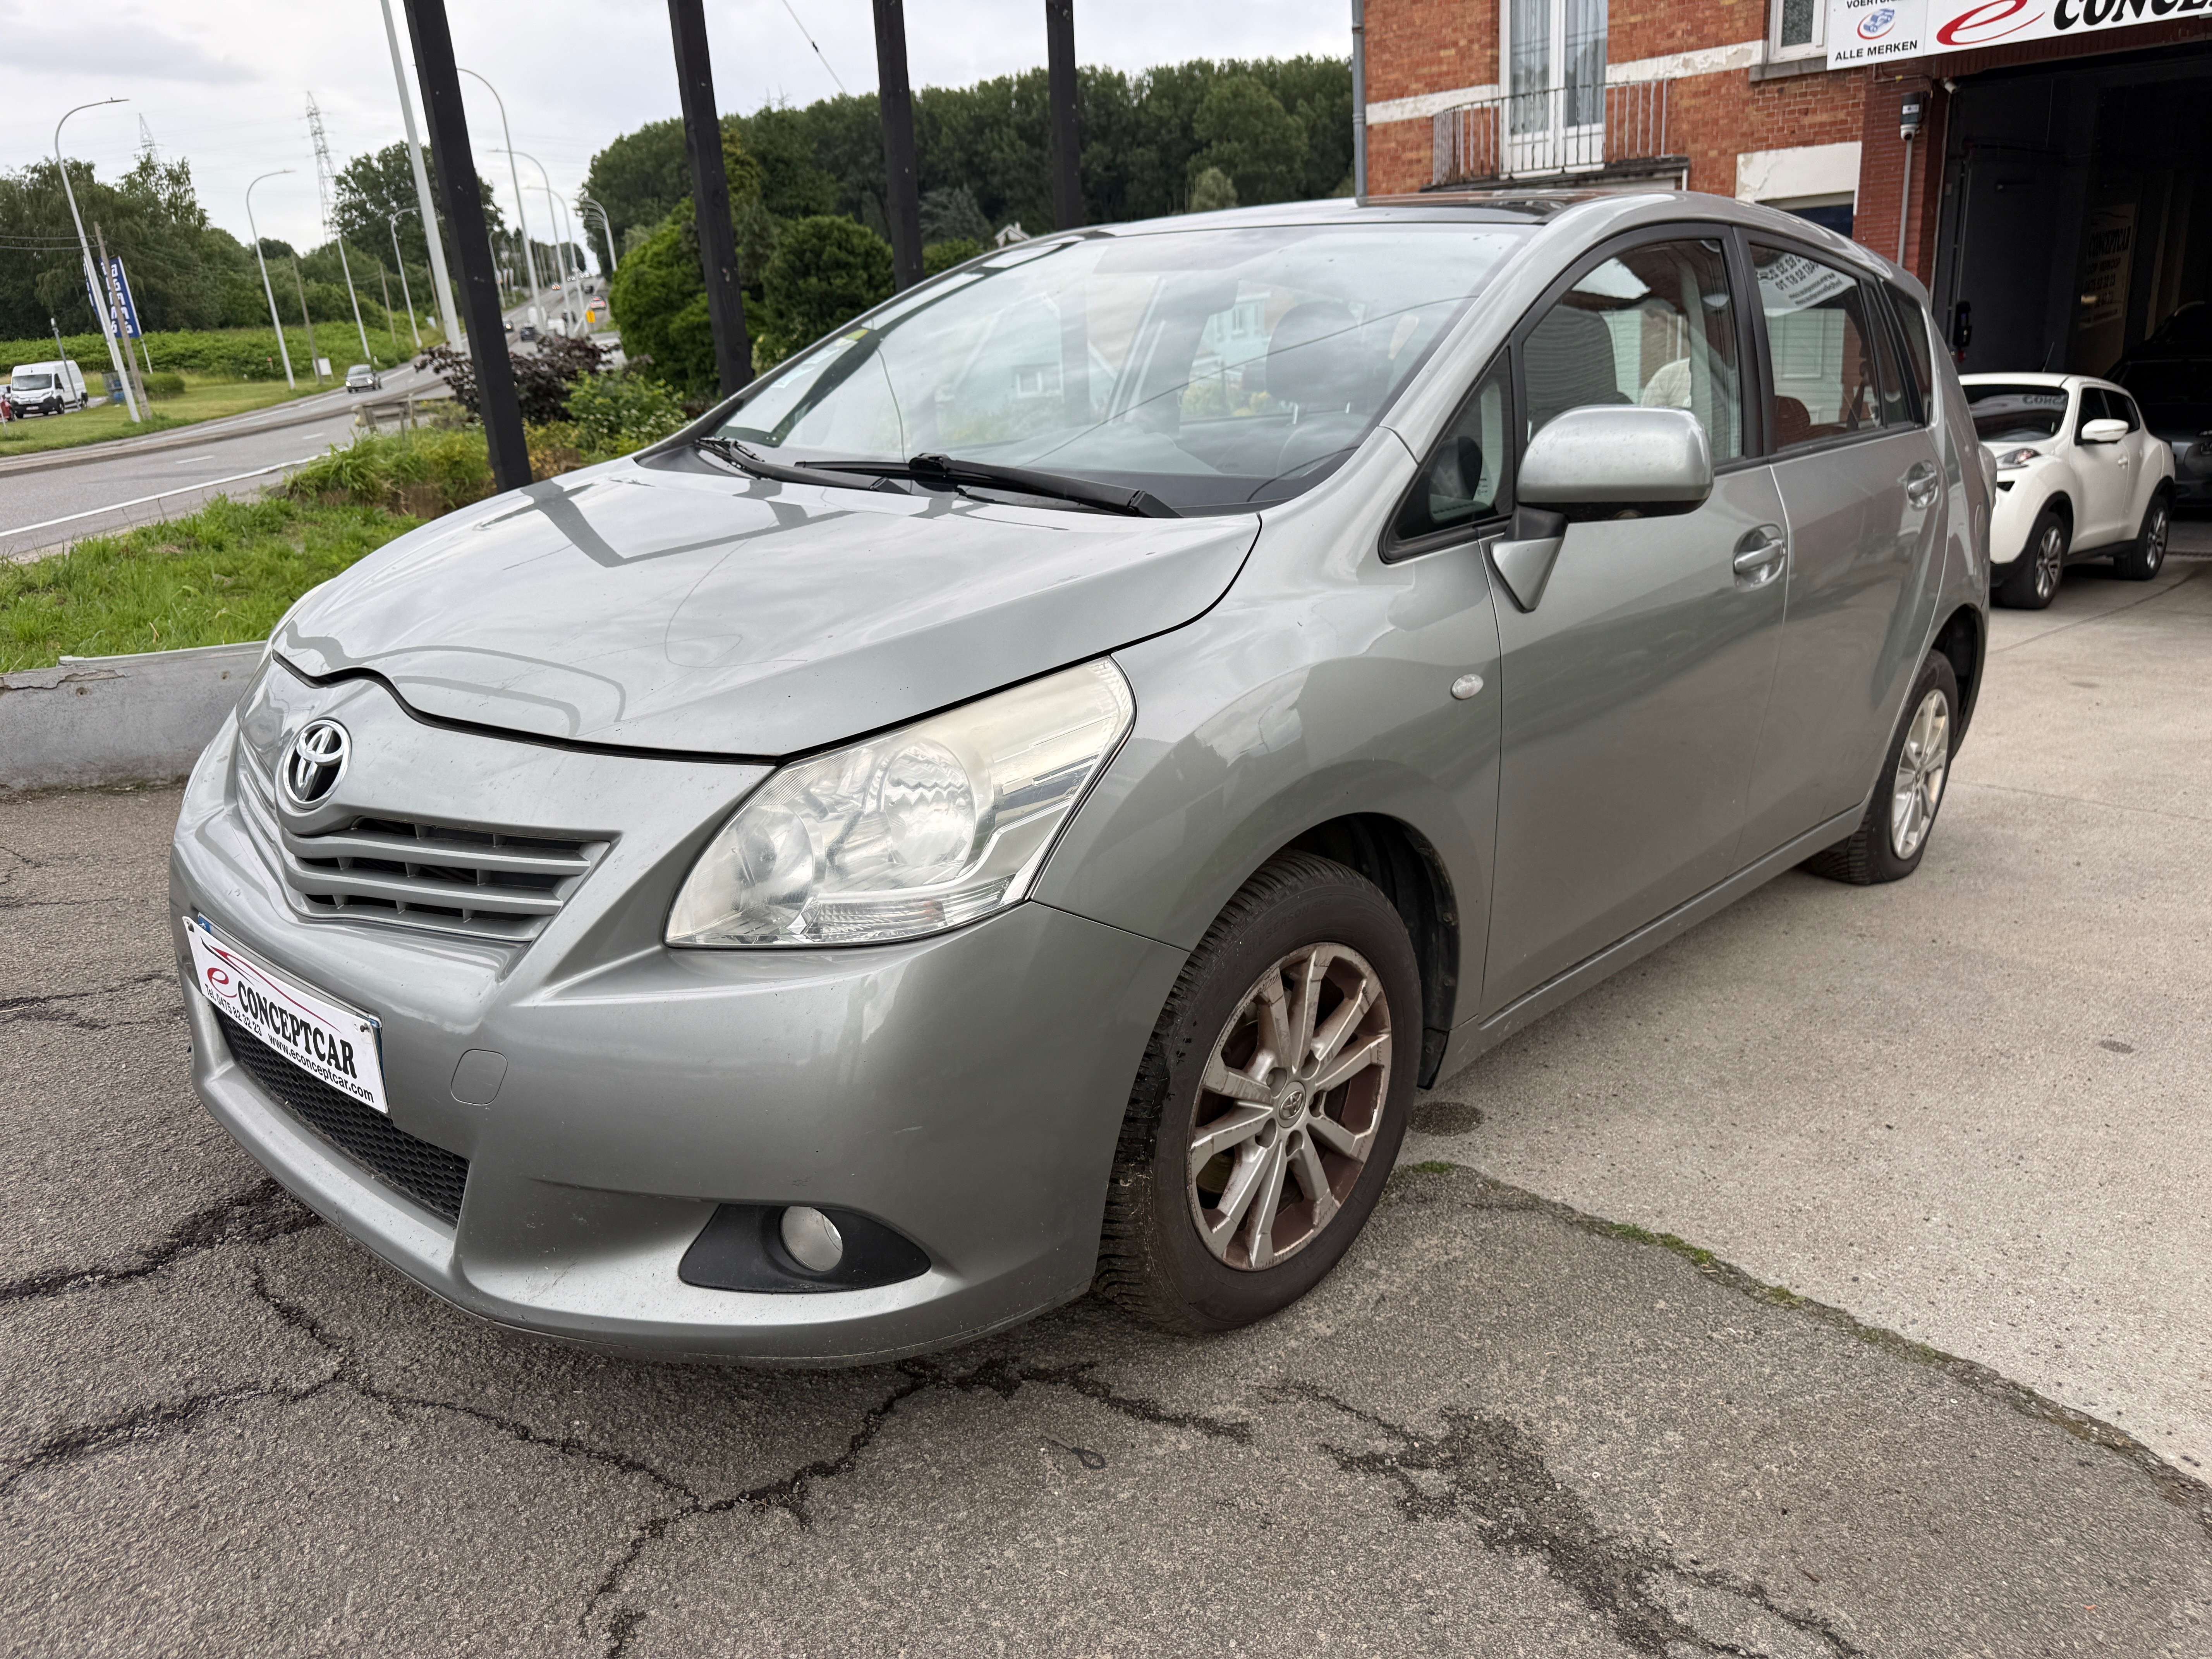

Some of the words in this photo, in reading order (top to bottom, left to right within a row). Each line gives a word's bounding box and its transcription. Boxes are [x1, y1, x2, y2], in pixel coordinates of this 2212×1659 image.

[1835, 48, 1863, 61] ALLE
[1867, 40, 1917, 57] MERKEN
[204, 983, 216, 1001] Tel.
[216, 993, 232, 1014] 0475
[232, 1006, 242, 1022] 82
[242, 1013, 252, 1029] 32
[252, 1021, 262, 1036] 23
[268, 1033, 374, 1103] www.econceptcar.com
[238, 981, 357, 1079] CONCEPTCAR
